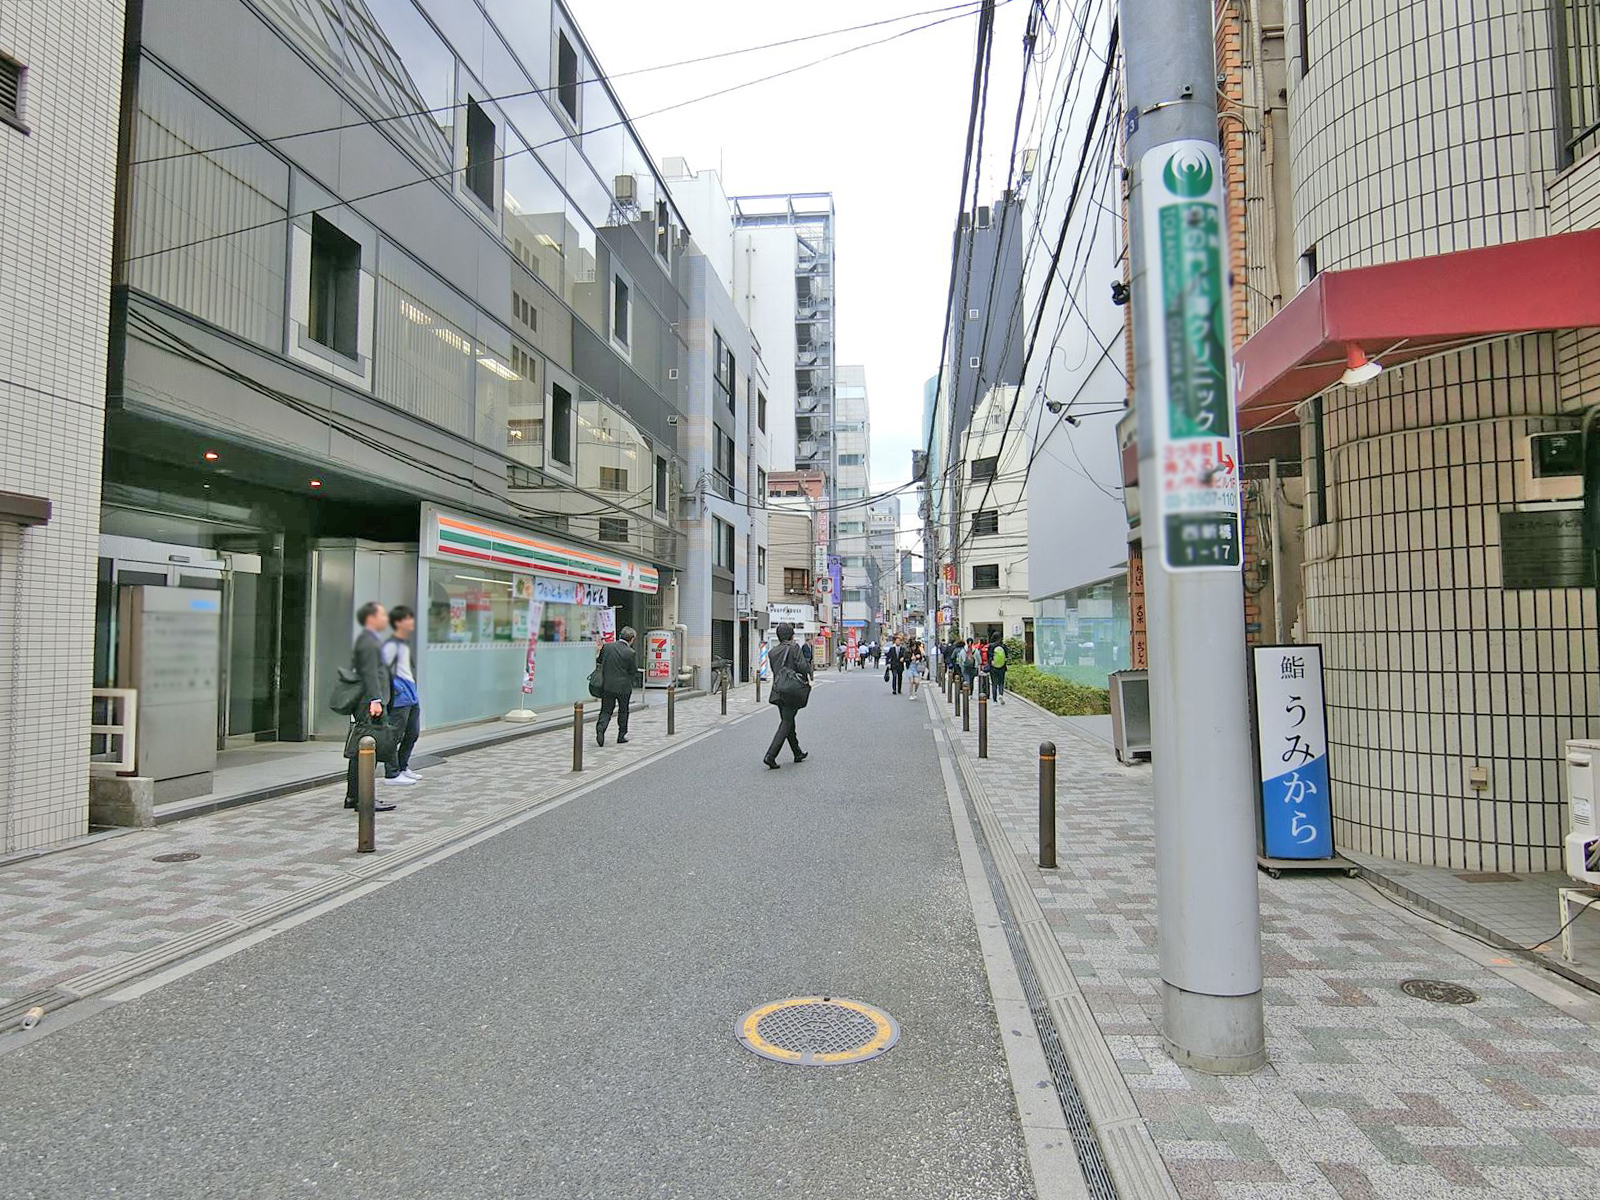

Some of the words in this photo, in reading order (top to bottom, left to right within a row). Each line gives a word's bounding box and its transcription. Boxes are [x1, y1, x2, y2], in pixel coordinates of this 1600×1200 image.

[1280, 655, 1305, 680] 鮨
[1281, 695, 1317, 844] うみから
